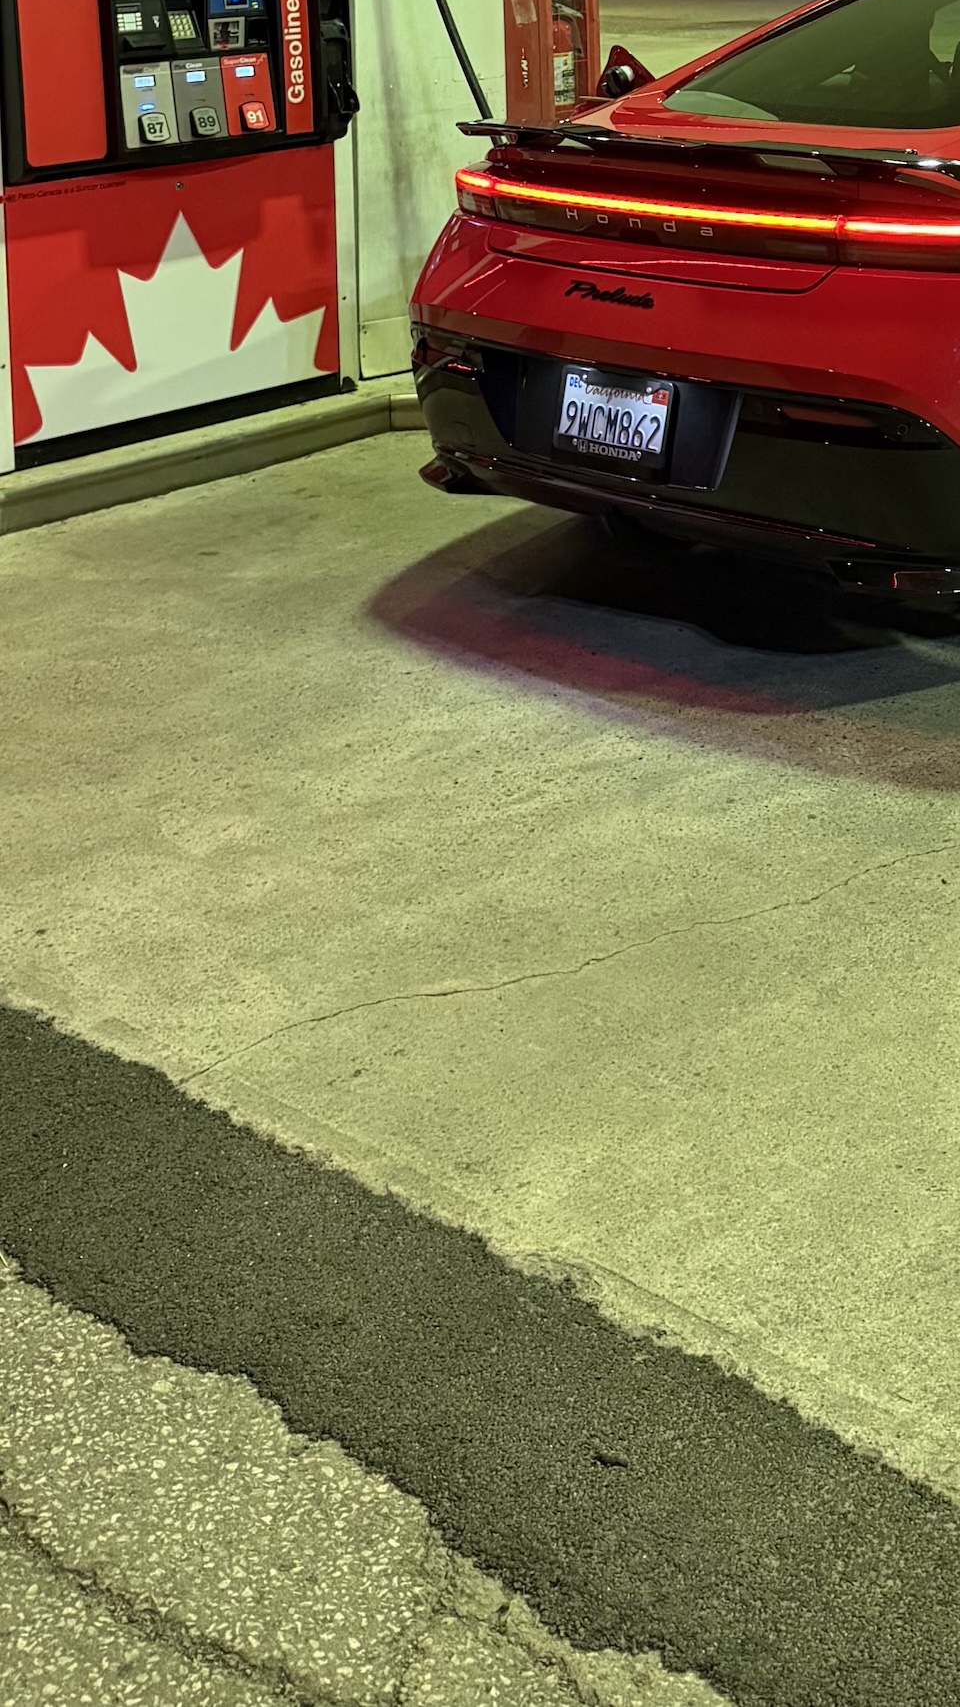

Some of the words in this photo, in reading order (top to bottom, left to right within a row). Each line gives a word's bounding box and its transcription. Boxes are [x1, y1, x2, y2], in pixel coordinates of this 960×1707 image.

[198, 115, 216, 129] 89
[247, 110, 264, 123] 91
[147, 122, 164, 134] 87
[564, 279, 655, 309] Prelude
[569, 376, 583, 388] DEC
[564, 400, 661, 452] 9WCM862
[588, 442, 639, 461] HONDA
